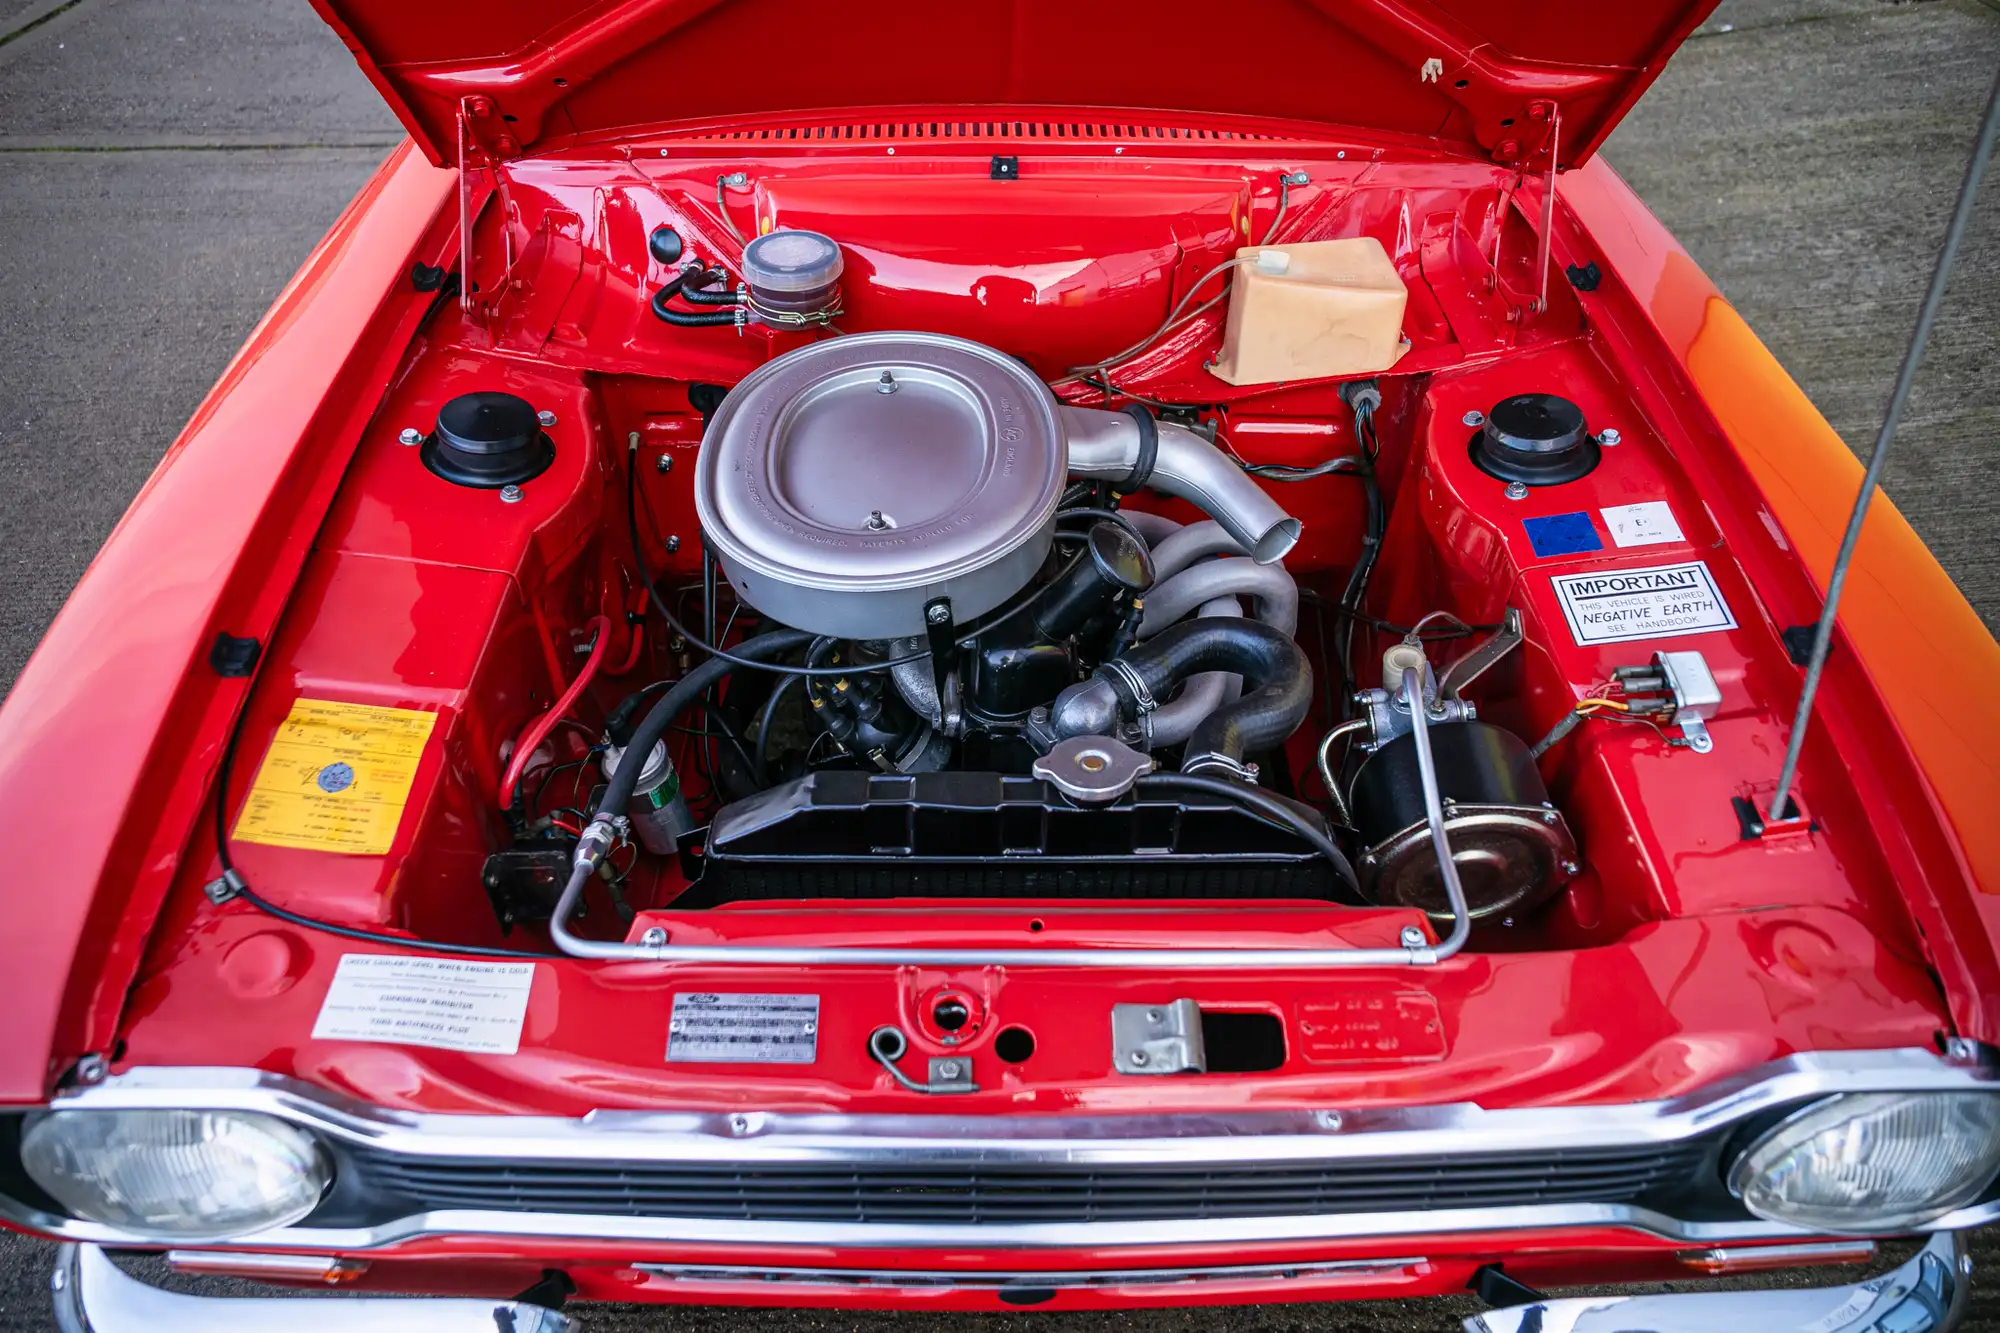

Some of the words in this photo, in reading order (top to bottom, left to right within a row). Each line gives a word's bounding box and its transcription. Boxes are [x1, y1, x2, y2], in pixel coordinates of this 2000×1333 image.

[799, 531, 848, 547] REQUIRED.
[860, 538, 907, 548] PATENTS
[912, 524, 953, 542] APPLIED
[955, 513, 976, 526] FOR
[1569, 570, 1698, 596] IMPORTANT
[1579, 602, 1602, 611] THIS
[1607, 597, 1650, 608] VEHICLE
[1654, 595, 1665, 604] IS
[1669, 590, 1705, 602] WIRED
[1583, 608, 1652, 625] NEGATIVE
[1663, 601, 1713, 616] EARTH
[1607, 624, 1627, 633] SEE
[1636, 615, 1701, 630] HANDBOOK
